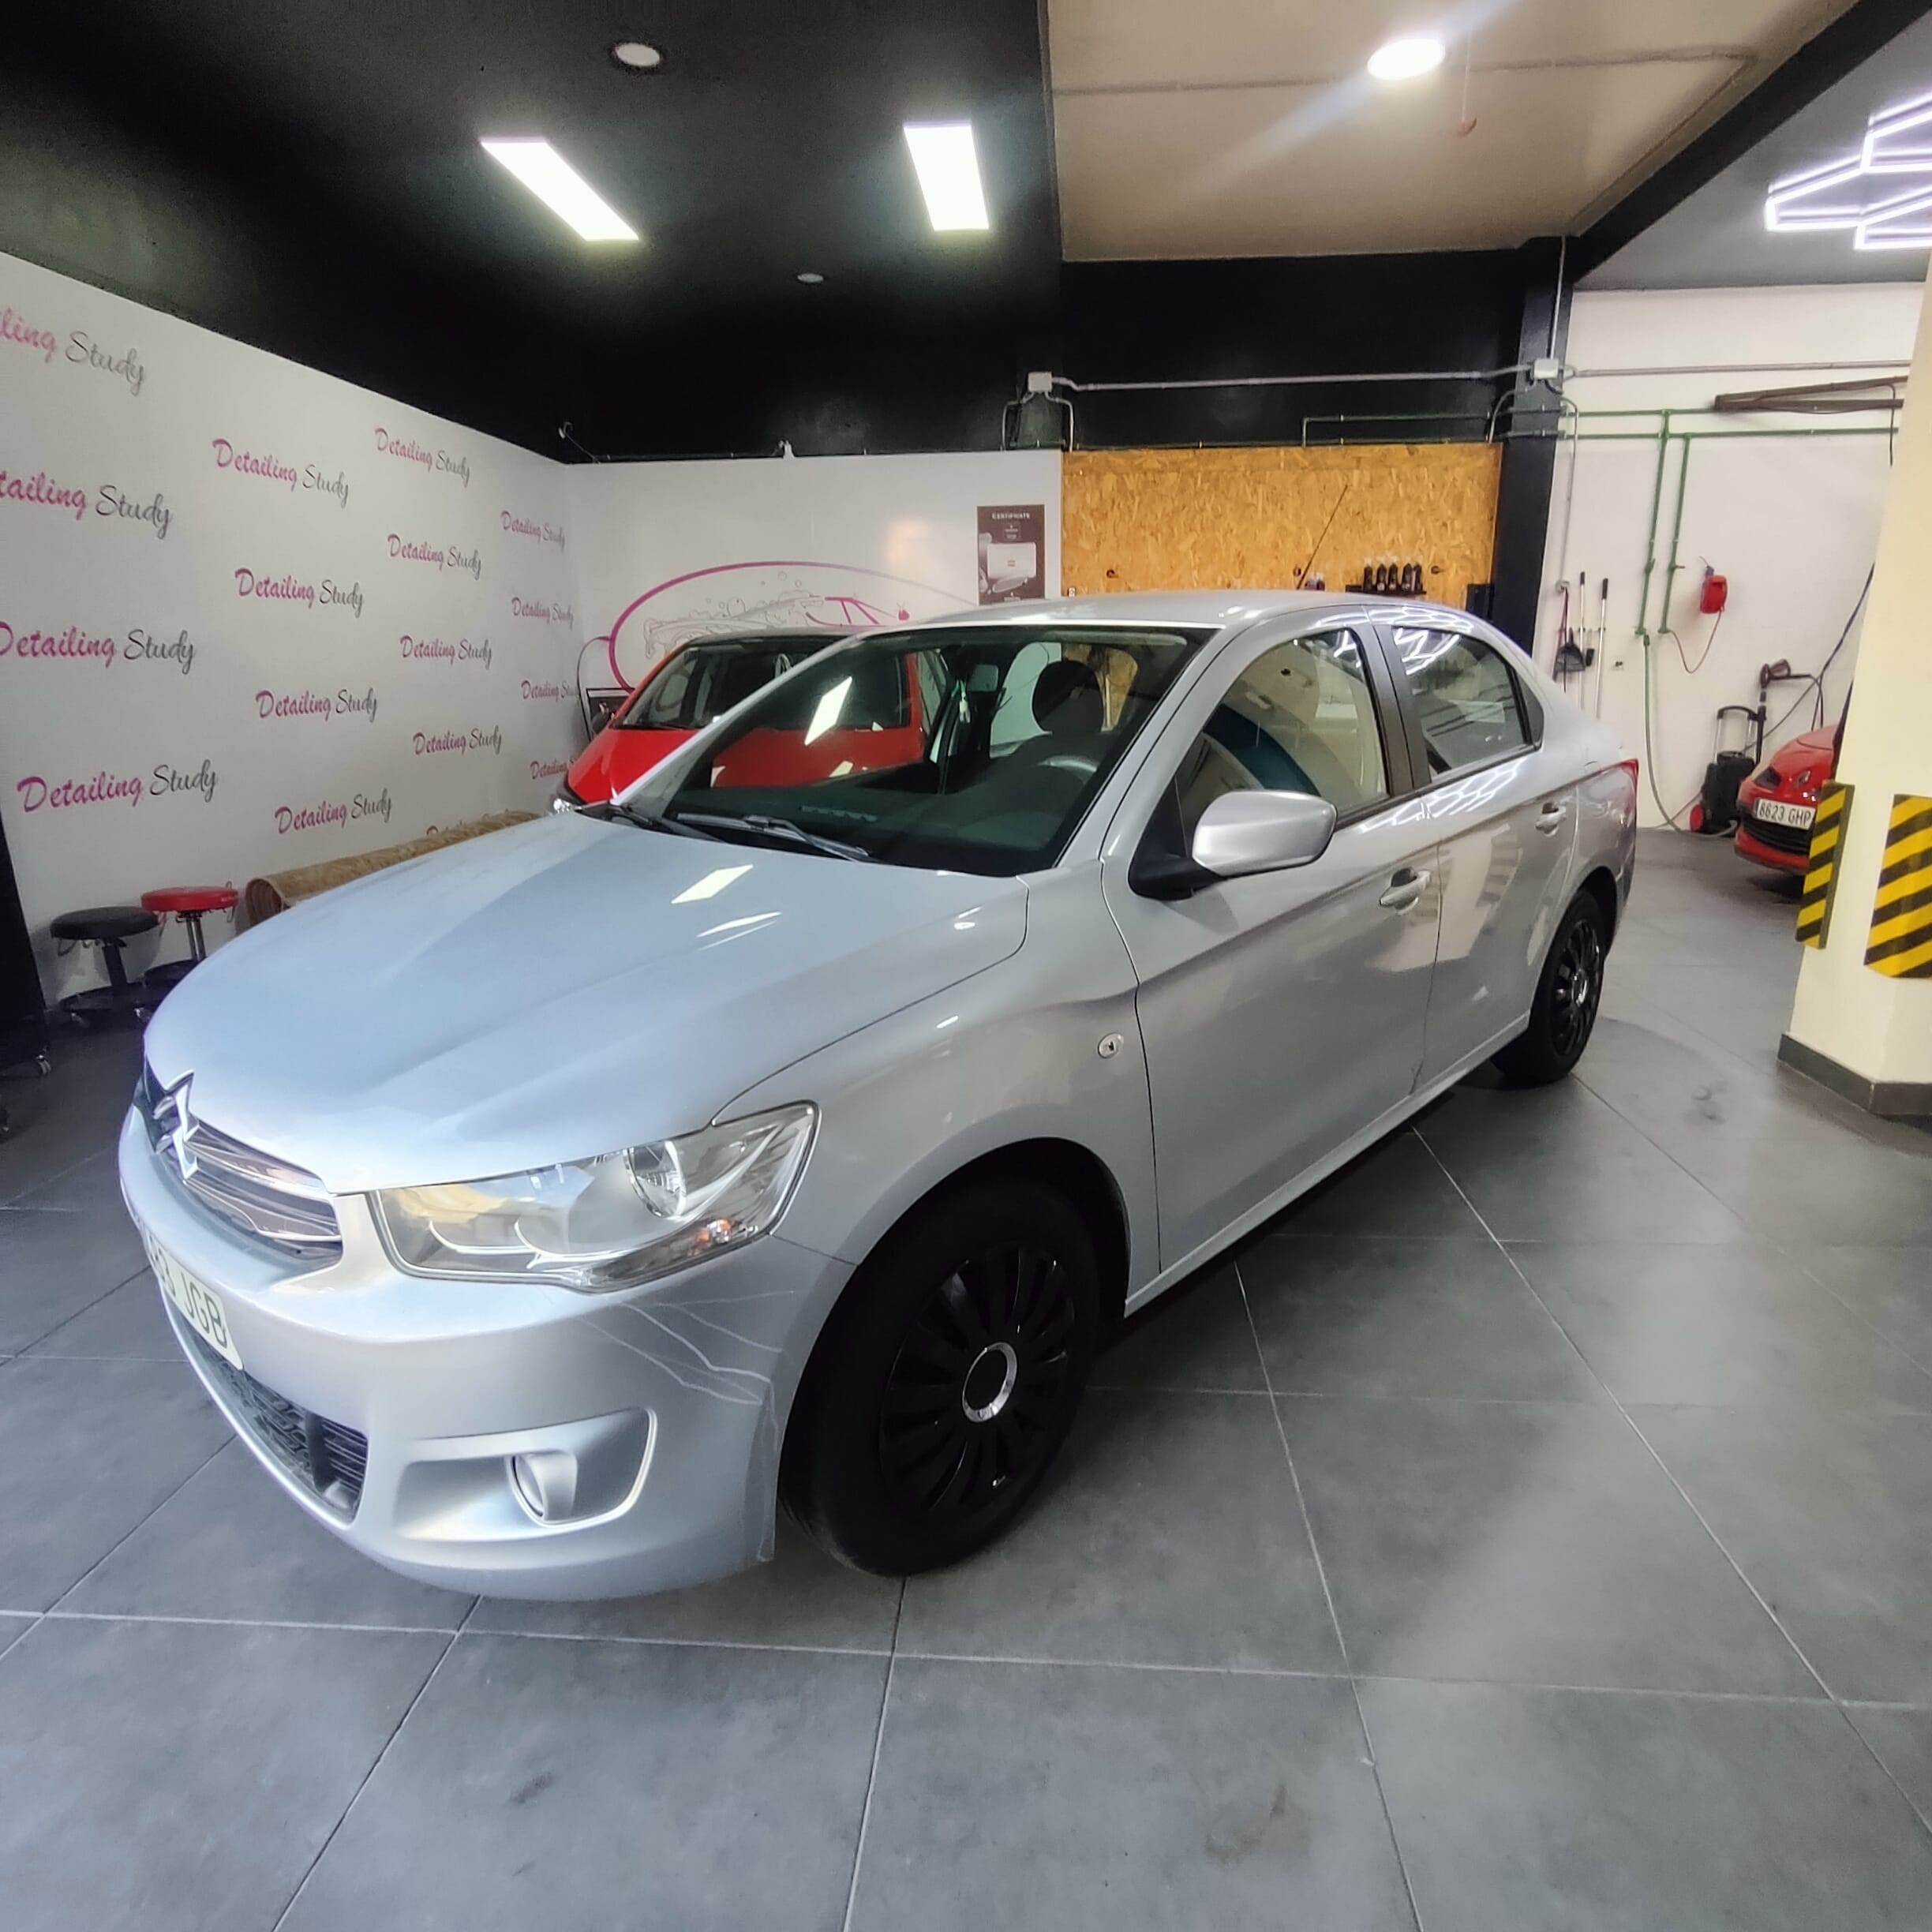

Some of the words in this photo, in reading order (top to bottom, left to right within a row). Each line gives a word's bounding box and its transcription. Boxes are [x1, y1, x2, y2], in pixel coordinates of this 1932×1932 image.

[65, 330, 144, 396] Study
[212, 438, 298, 492] Detailing
[302, 464, 348, 509] Study
[374, 428, 432, 473] Detailing
[436, 450, 470, 488] Study
[95, 485, 170, 540] Study
[501, 511, 541, 543] Detailing
[543, 522, 565, 554] Study
[387, 534, 444, 571] Detailing
[447, 546, 481, 581] Study
[234, 567, 315, 609] Detailing
[319, 579, 363, 619] Study
[511, 597, 551, 624] Detailing
[123, 629, 196, 675] Study
[400, 635, 455, 665] Detailing
[458, 638, 492, 670] Study
[256, 690, 331, 721] Detailing
[335, 687, 377, 723] Study
[521, 680, 559, 702] Detailing
[412, 731, 466, 755] Detailing
[469, 724, 502, 755] Study
[17, 771, 143, 813] Detailing
[149, 758, 218, 803] Study
[530, 759, 568, 780] Detailing
[275, 800, 347, 834] Detailing
[351, 788, 392, 822] Study
[1788, 808, 1811, 826] GHP
[181, 1271, 227, 1349] JGB
